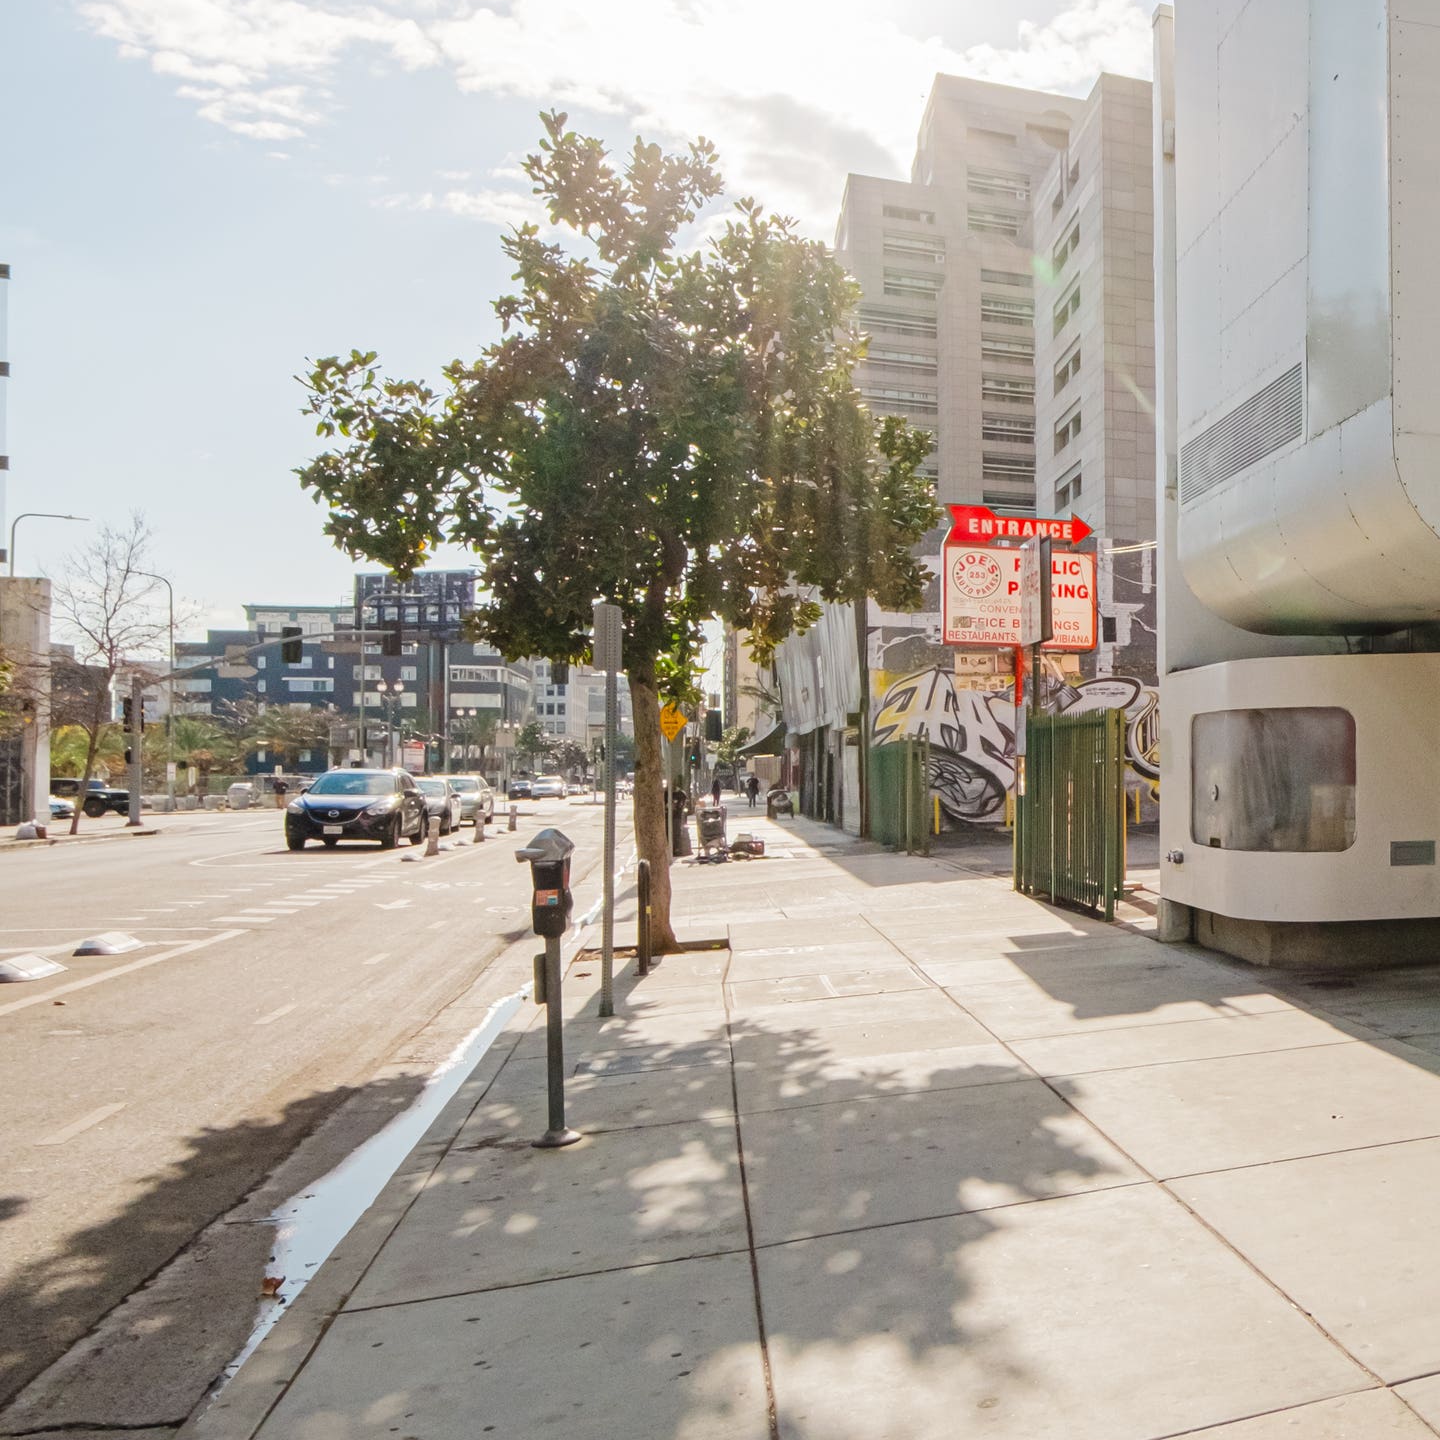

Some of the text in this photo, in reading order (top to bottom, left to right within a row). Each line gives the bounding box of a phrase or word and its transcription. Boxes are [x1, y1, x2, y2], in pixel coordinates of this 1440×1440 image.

[968, 518, 1072, 539] ENTRANCE
[958, 555, 998, 575] JOE'S
[1014, 558, 1080, 576] PLIC
[969, 571, 986, 579] 253
[956, 575, 999, 596] AUTO PARKS
[970, 617, 1007, 629] FFICE
